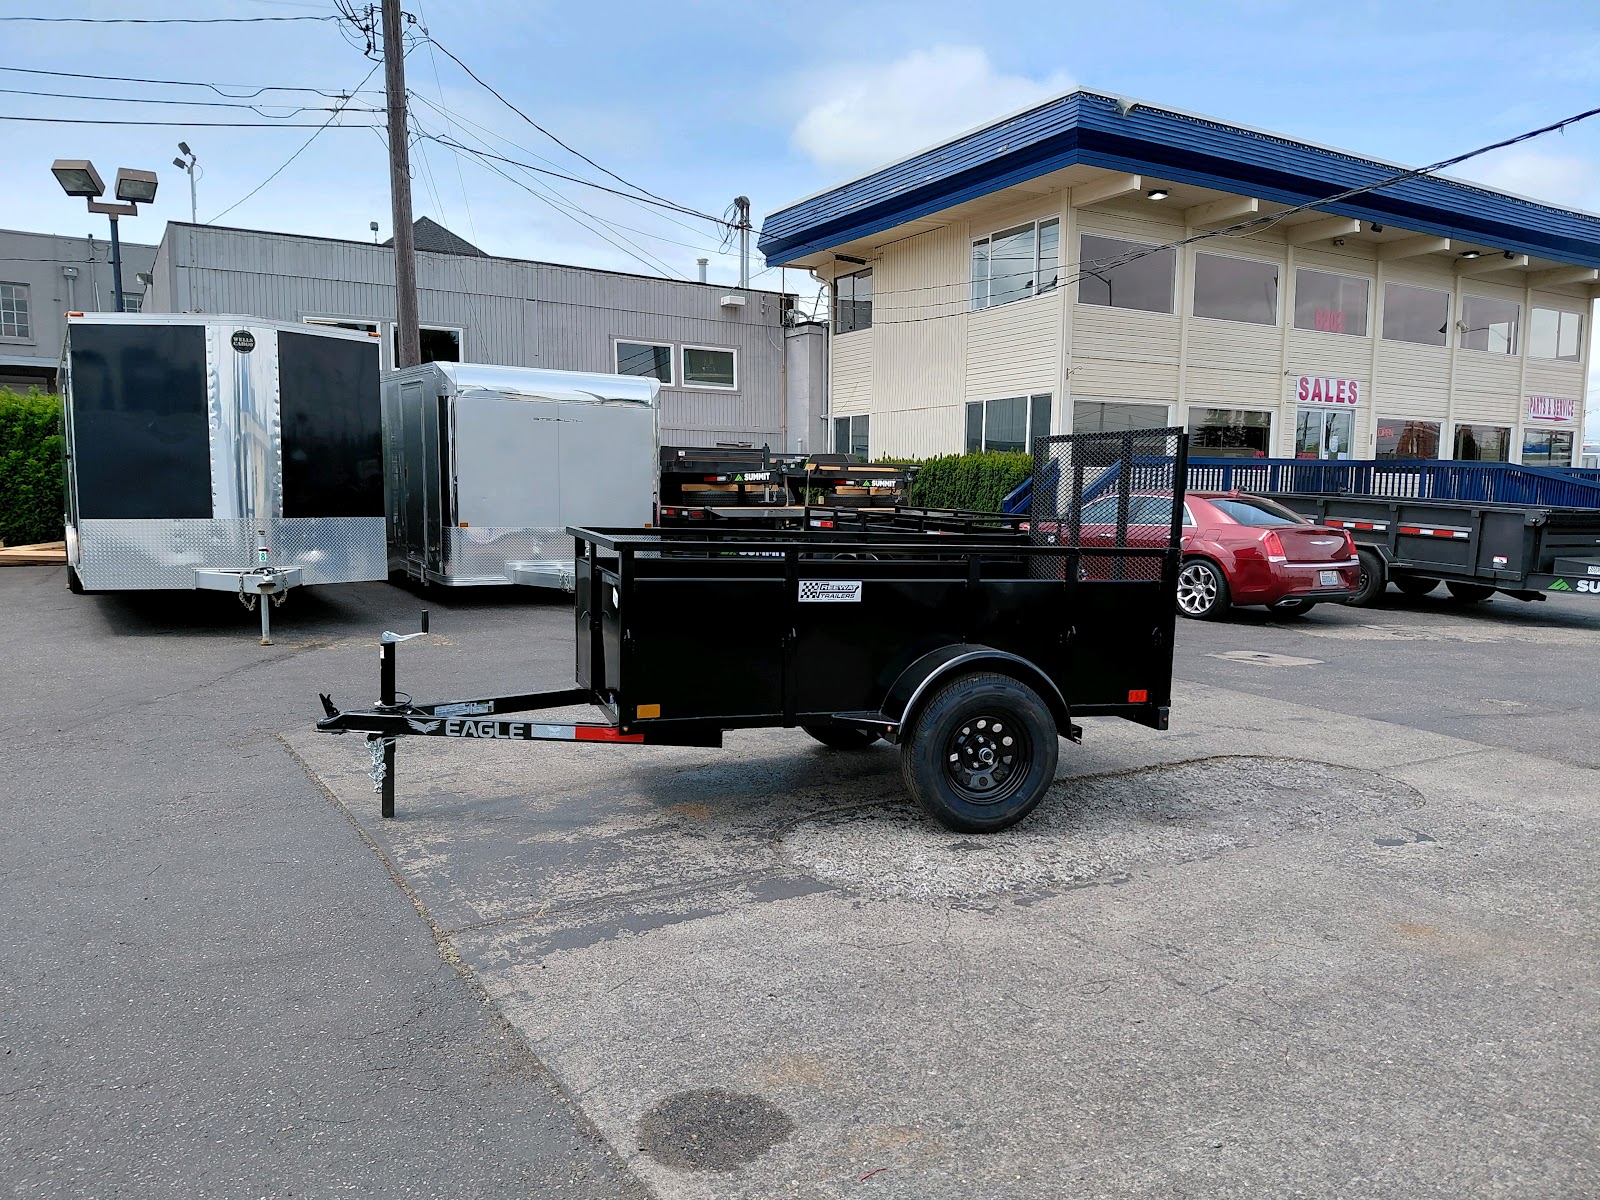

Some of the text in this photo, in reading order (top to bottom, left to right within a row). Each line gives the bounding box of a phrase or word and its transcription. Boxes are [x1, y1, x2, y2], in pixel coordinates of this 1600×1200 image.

[1298, 377, 1358, 405] SALES
[1529, 397, 1547, 415] PARTS
[1553, 399, 1575, 417] SERVICE
[743, 472, 771, 481] SUMMIT
[445, 720, 525, 739] EAGLE
